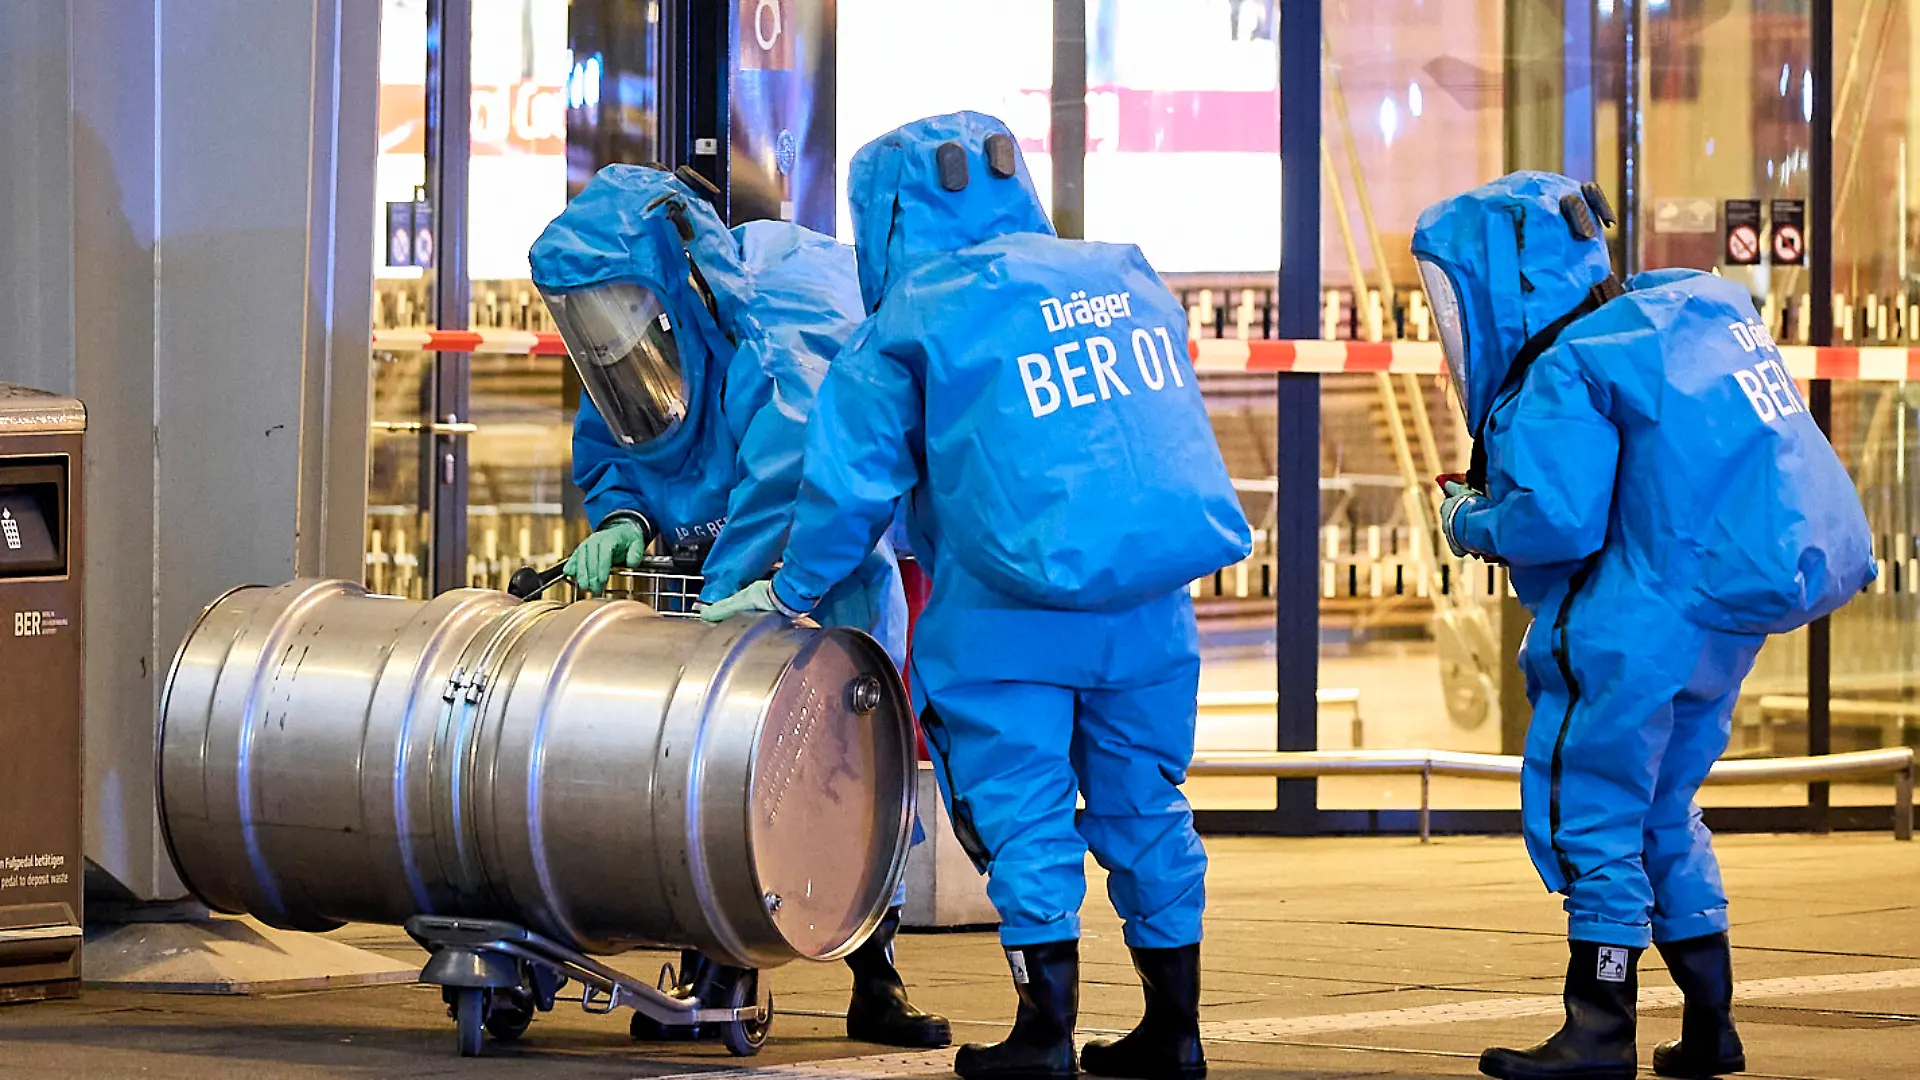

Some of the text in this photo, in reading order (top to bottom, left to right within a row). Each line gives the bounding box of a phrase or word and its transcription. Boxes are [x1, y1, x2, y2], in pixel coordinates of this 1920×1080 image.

[1040, 290, 1132, 333] Dräger
[1017, 326, 1185, 418] BER 01
[15, 611, 41, 637] BER
[35, 853, 64, 869] betätigen
[1, 872, 68, 890] pedal to deposit waste
